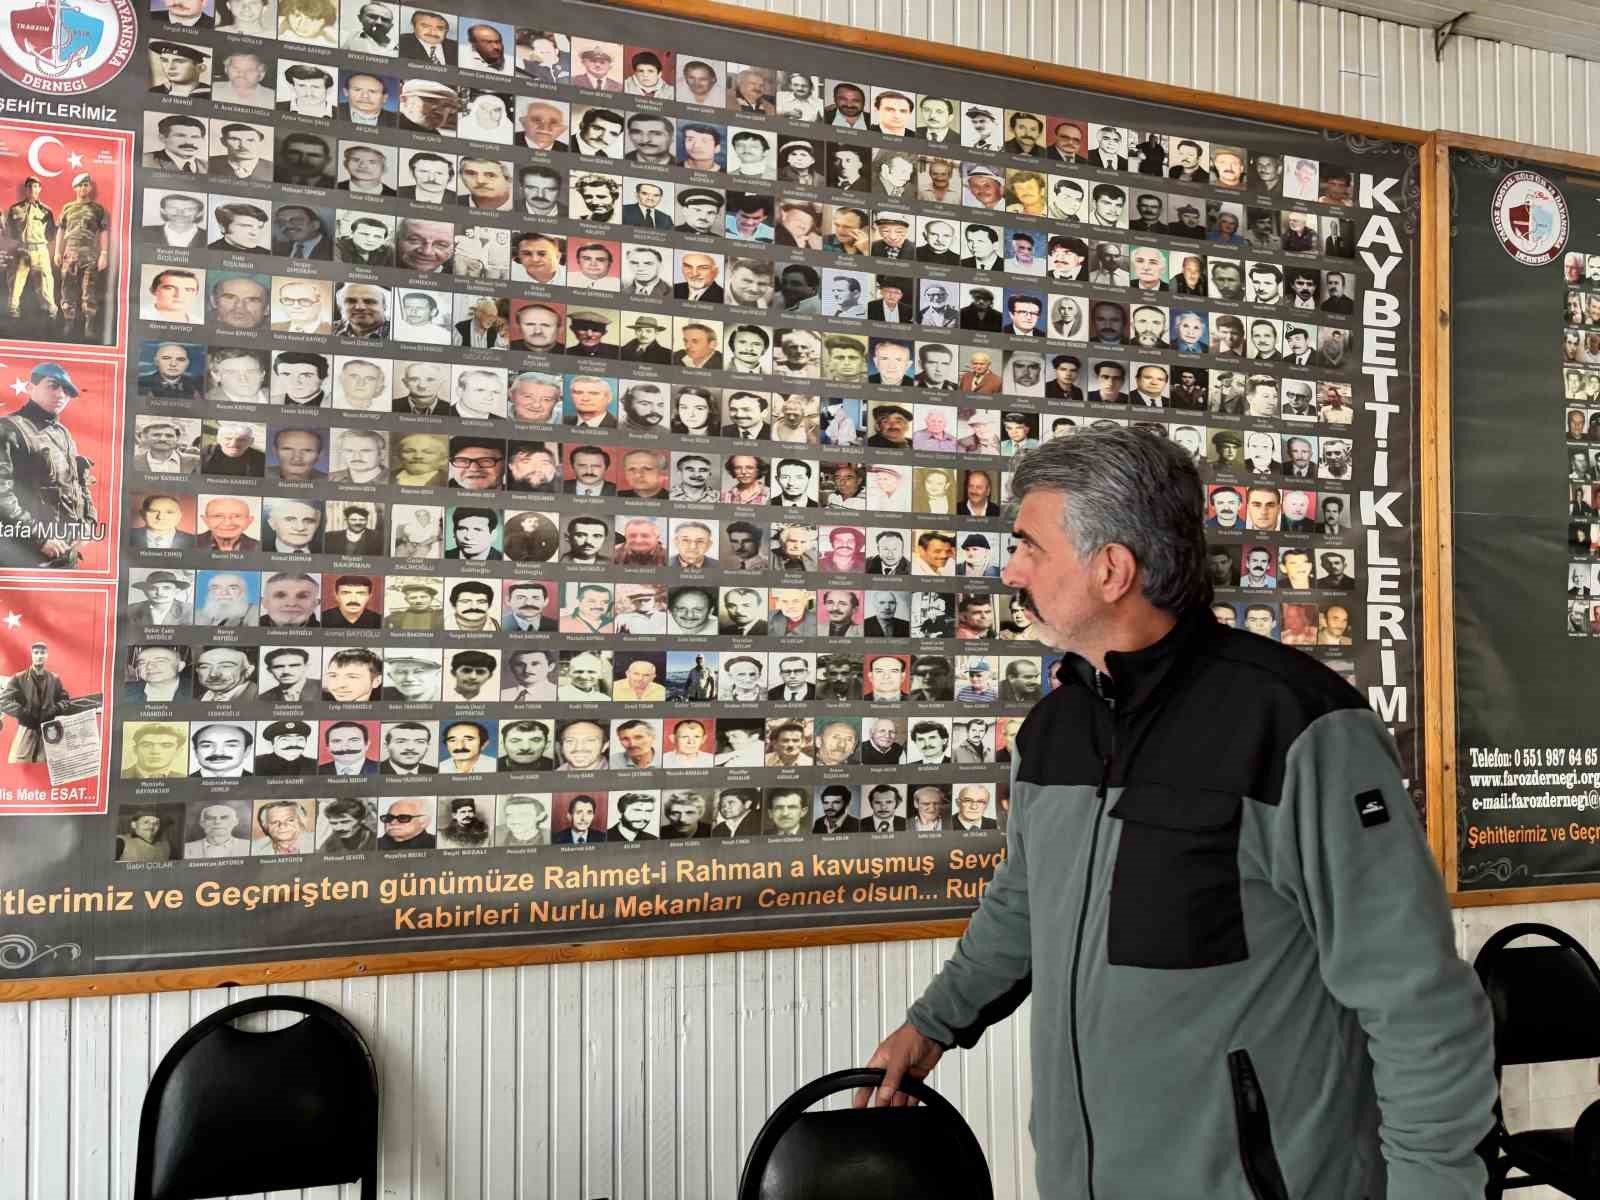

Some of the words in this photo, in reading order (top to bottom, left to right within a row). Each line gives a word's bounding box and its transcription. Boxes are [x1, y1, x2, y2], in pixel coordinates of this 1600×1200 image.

[1357, 173, 1408, 789] KAYBETTİKLERİM
[38, 521, 105, 541] MUTLU
[1470, 747, 1512, 768] Telefon:
[1514, 748, 1521, 767] 0
[1523, 748, 1542, 767] 551
[1546, 748, 1566, 767] 987
[1568, 748, 1582, 766] 64
[1584, 747, 1598, 766] 65
[1470, 769, 1600, 789] www.farozdernegi.org
[17, 787, 46, 800] Mete
[51, 787, 96, 800] ESAT...
[1472, 789, 1600, 811] e-mail:farozdernegi@
[1468, 824, 1548, 848] Şehitlerimiz
[1551, 827, 1566, 841] ve
[0, 887, 133, 916] tlerimiz
[144, 888, 185, 910] ve
[195, 876, 369, 911] Geçmişten
[379, 869, 535, 905] günümüze
[543, 861, 667, 890] Rahmet-i
[676, 857, 783, 883] Rahman
[790, 860, 805, 877] a
[812, 853, 936, 879] kavuşmuş
[394, 901, 520, 930] Kabirleri
[529, 896, 605, 923] Nurlu
[614, 890, 742, 918] Mekanları
[758, 885, 847, 909] Cennet
[852, 882, 938, 905] olsun...
